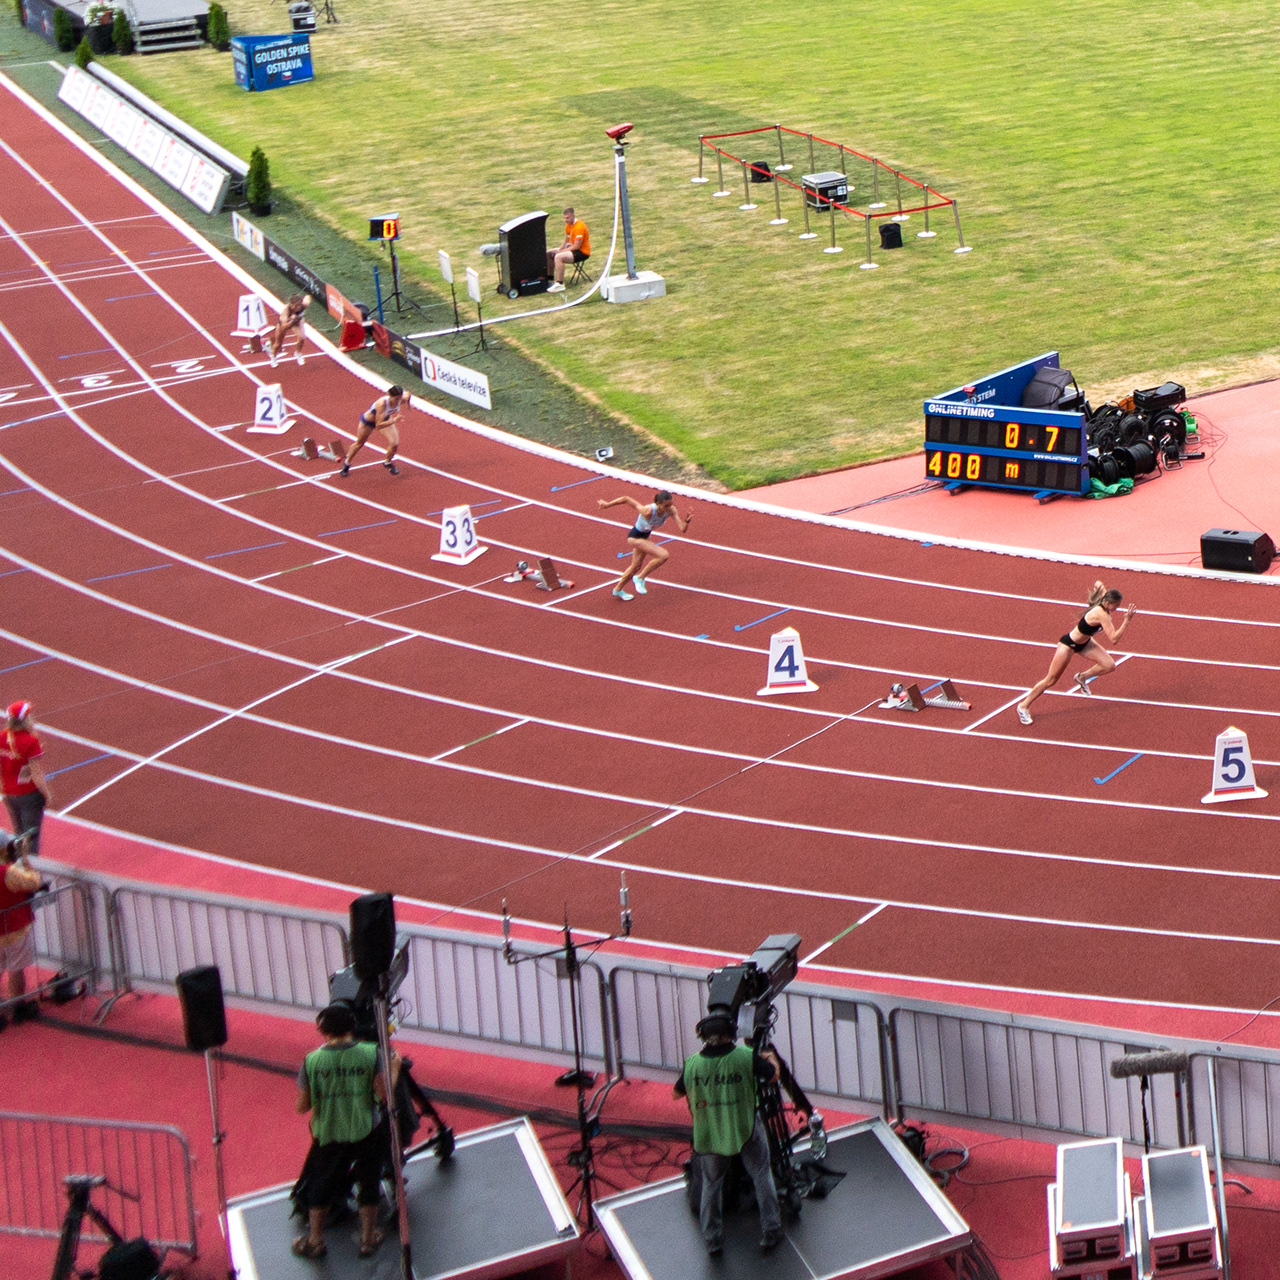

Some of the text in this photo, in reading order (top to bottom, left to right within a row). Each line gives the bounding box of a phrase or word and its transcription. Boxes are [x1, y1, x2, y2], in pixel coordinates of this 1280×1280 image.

[255, 47, 288, 64] GOLDEN
[288, 44, 310, 59] SPIKE
[266, 58, 303, 75] OSTRAVA
[382, 219, 397, 240] 0
[242, 304, 251, 327] 1
[256, 300, 265, 327] 1
[437, 364, 487, 398] Česká televize
[260, 396, 273, 421] 2
[928, 404, 995, 419] ONLINETIMING
[928, 451, 1020, 480] 400 m
[445, 520, 458, 549] 3
[462, 517, 473, 547] 3
[774, 644, 799, 678] 4
[1221, 746, 1246, 784] 5
